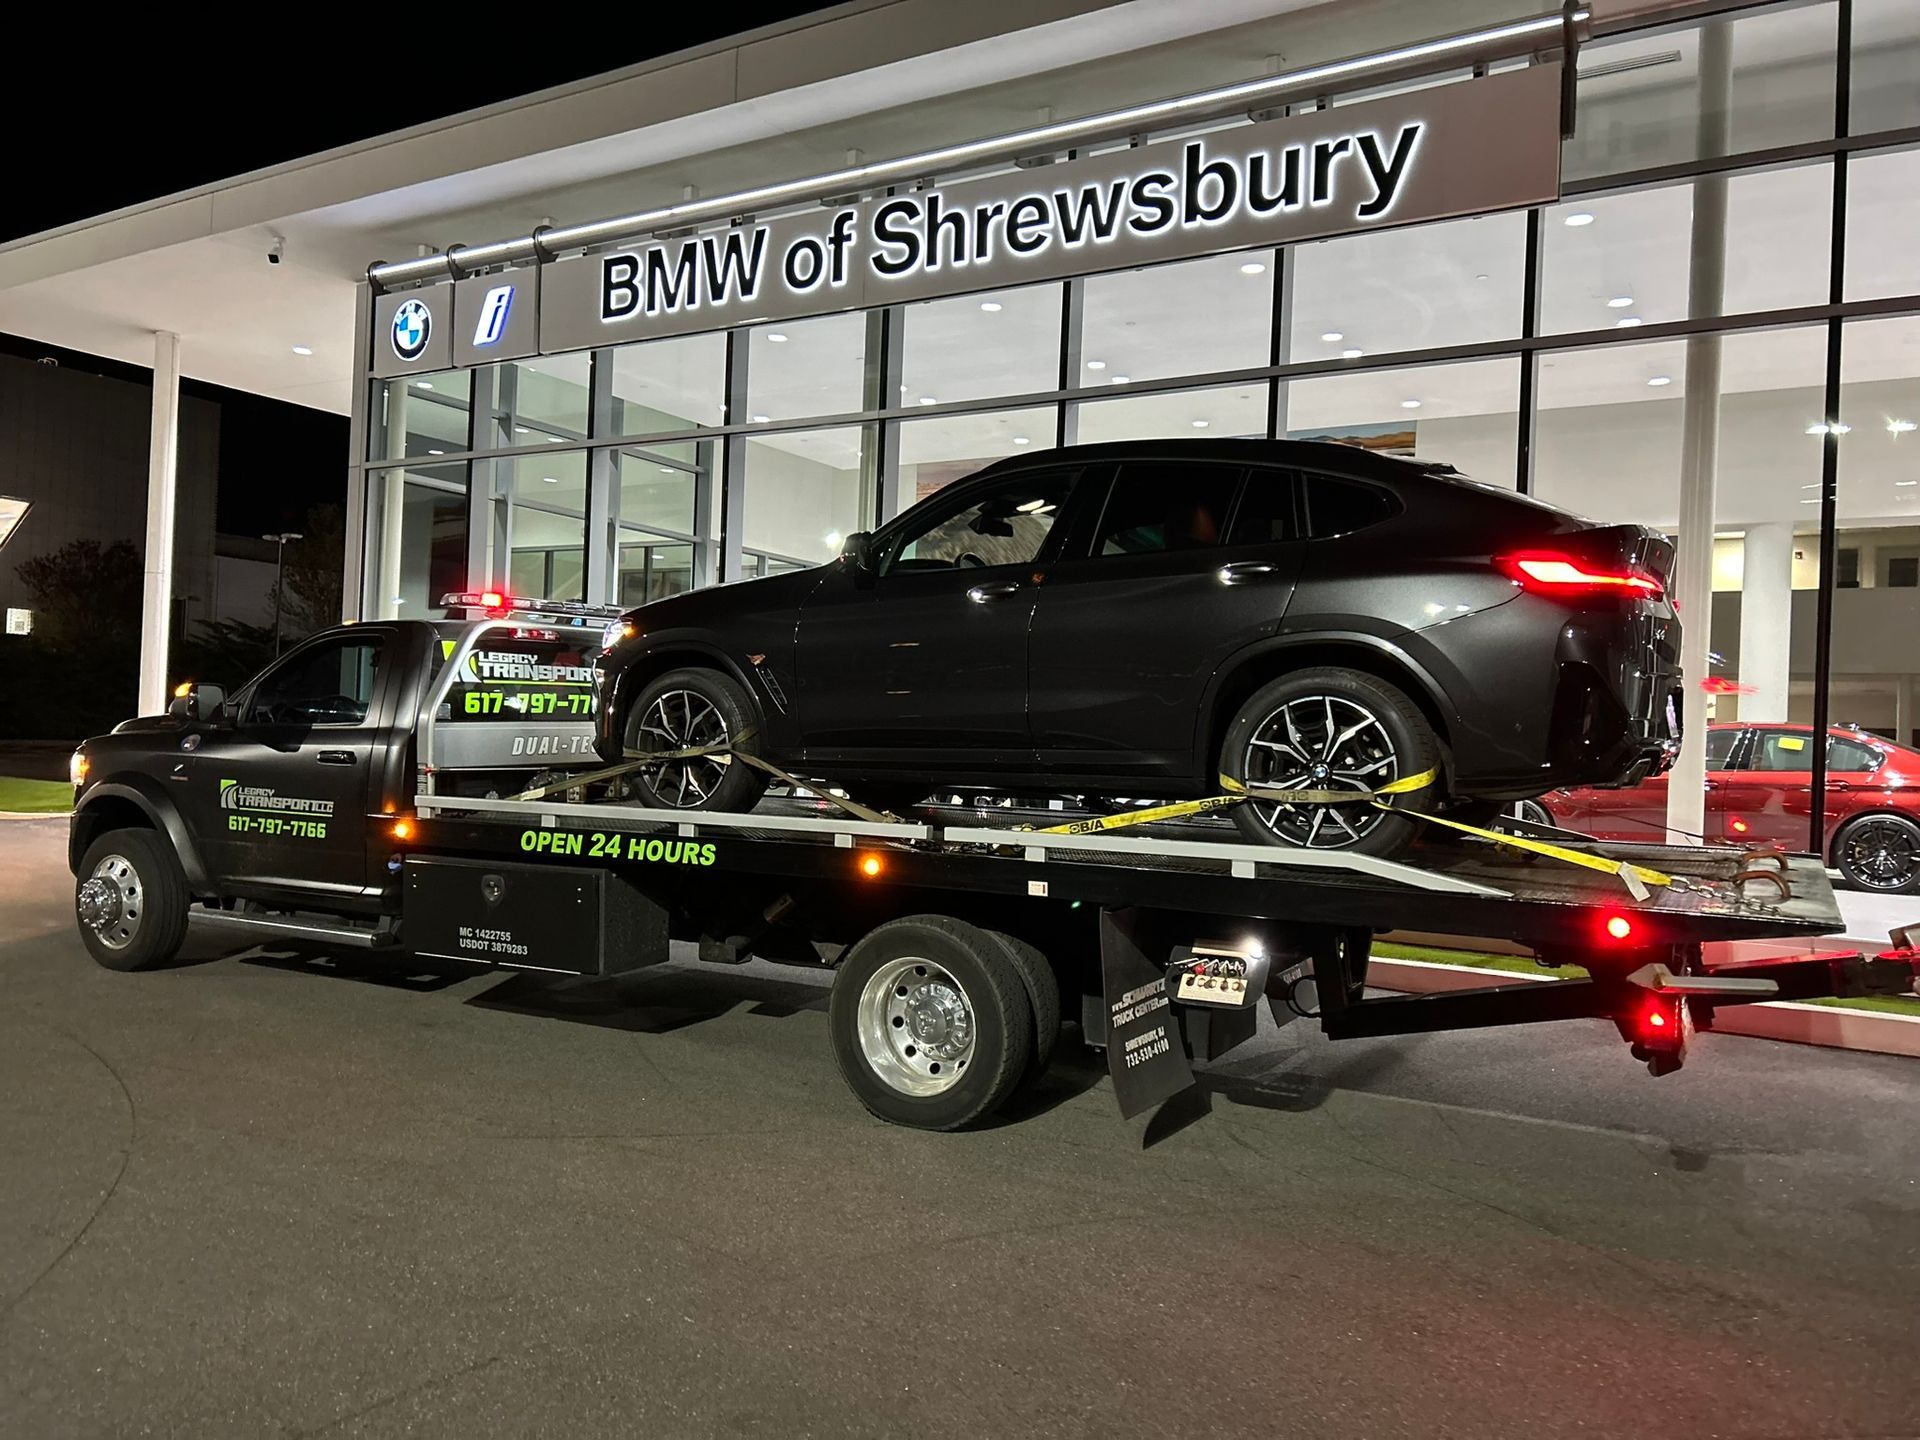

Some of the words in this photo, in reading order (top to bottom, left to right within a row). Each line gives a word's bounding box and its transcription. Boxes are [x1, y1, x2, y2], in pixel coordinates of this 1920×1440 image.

[602, 229, 767, 320] BMW
[785, 211, 855, 290] of
[870, 125, 1422, 274] Shrewsbury
[478, 651, 538, 664] LEGACY
[478, 662, 593, 682] TRANSPOR
[464, 692, 592, 714] 617-797-77
[238, 787, 275, 797] LEGACY
[238, 795, 323, 811] TRANSPORT
[228, 815, 326, 838] 617-797-7766
[520, 830, 583, 855] OPEN
[588, 833, 621, 858] 24
[628, 838, 716, 866] HOURS
[459, 927, 473, 937] MC
[475, 928, 511, 941] 1422755
[459, 938, 489, 950] USDOT
[491, 942, 528, 955] 3879283
[1112, 1007, 1135, 1028] TRUCK
